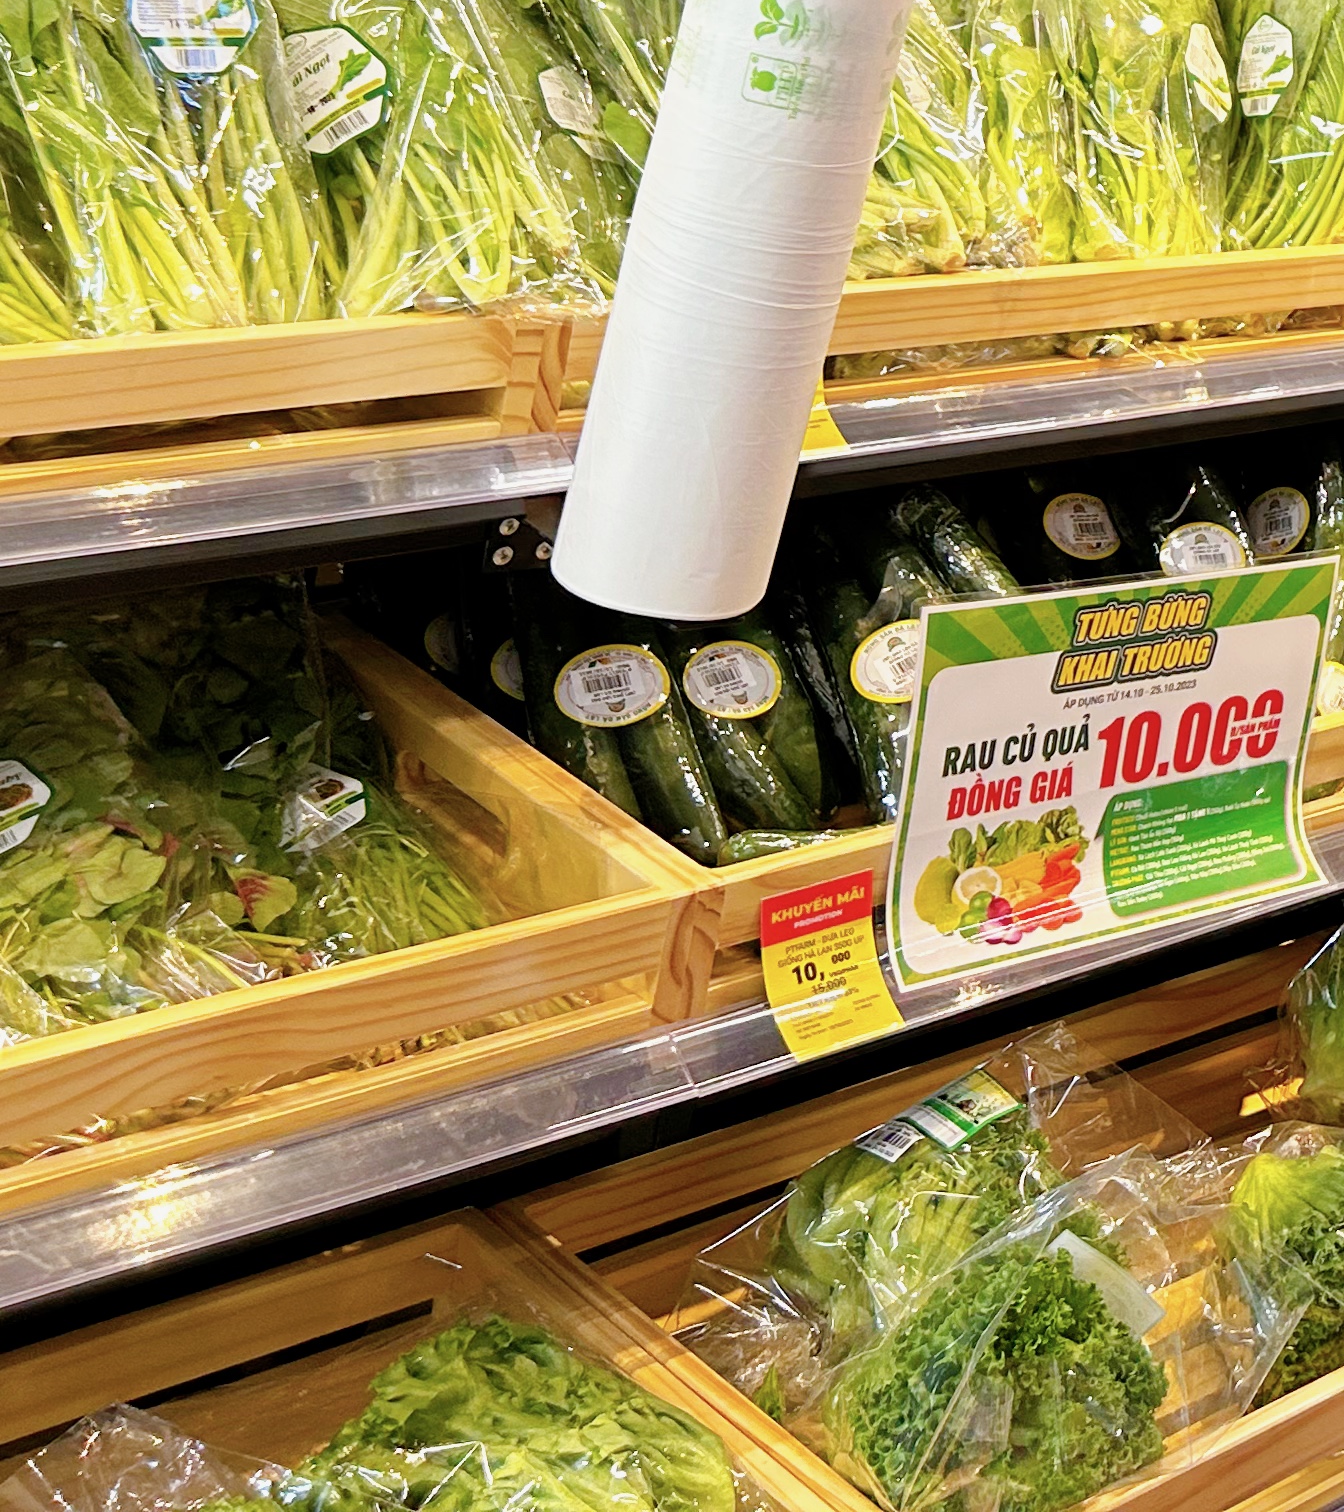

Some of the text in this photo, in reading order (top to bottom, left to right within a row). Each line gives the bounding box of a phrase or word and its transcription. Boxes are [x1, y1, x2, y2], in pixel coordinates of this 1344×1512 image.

[1142, 594, 1209, 635] BỪNG
[1057, 649, 1120, 687] KHAI
[1063, 696, 1077, 710] ÁP
[1078, 694, 1105, 709] DỤNG
[1120, 687, 1144, 700] 14.10
[1150, 679, 1197, 696] 25.10.2023
[942, 689, 1285, 789] RAU CỦ QUẢ 10.000
[946, 761, 1074, 821] ĐỒNG GIÁ
[771, 886, 865, 925] KHUYẾN MÃI
[791, 961, 825, 985] 10,
[831, 950, 851, 965] 000
[816, 945, 833, 959] LAN
